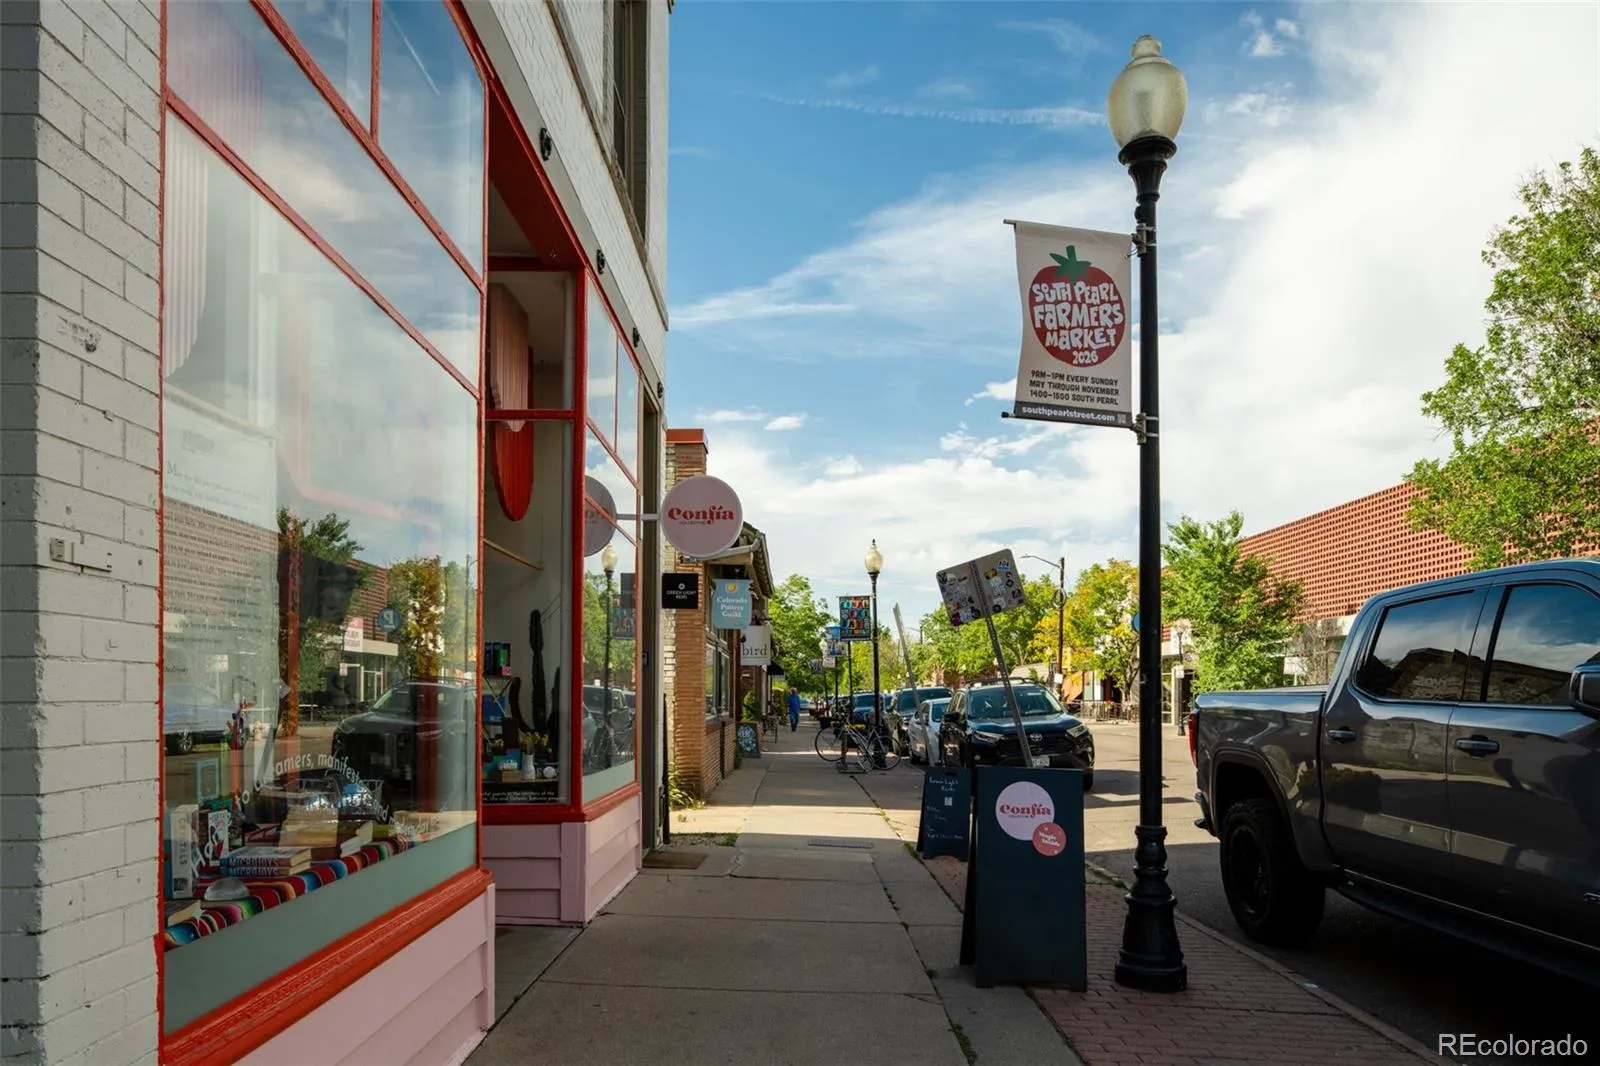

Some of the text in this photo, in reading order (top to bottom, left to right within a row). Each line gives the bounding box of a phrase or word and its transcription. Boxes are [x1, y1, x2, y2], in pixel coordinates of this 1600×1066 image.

[1072, 351, 1099, 365] 2026
[1066, 374, 1089, 383] EVERY
[1091, 376, 1119, 386] SUNDAY
[1029, 379, 1120, 396] MAY THROUGH NOVEMBER
[1071, 393, 1095, 402] SOUTH
[1096, 396, 1119, 405] PEARL
[1021, 406, 1115, 422] southpearlstreet.com
[667, 505, 734, 525] Confía
[720, 603, 744, 611] Potters
[742, 643, 768, 656] bird
